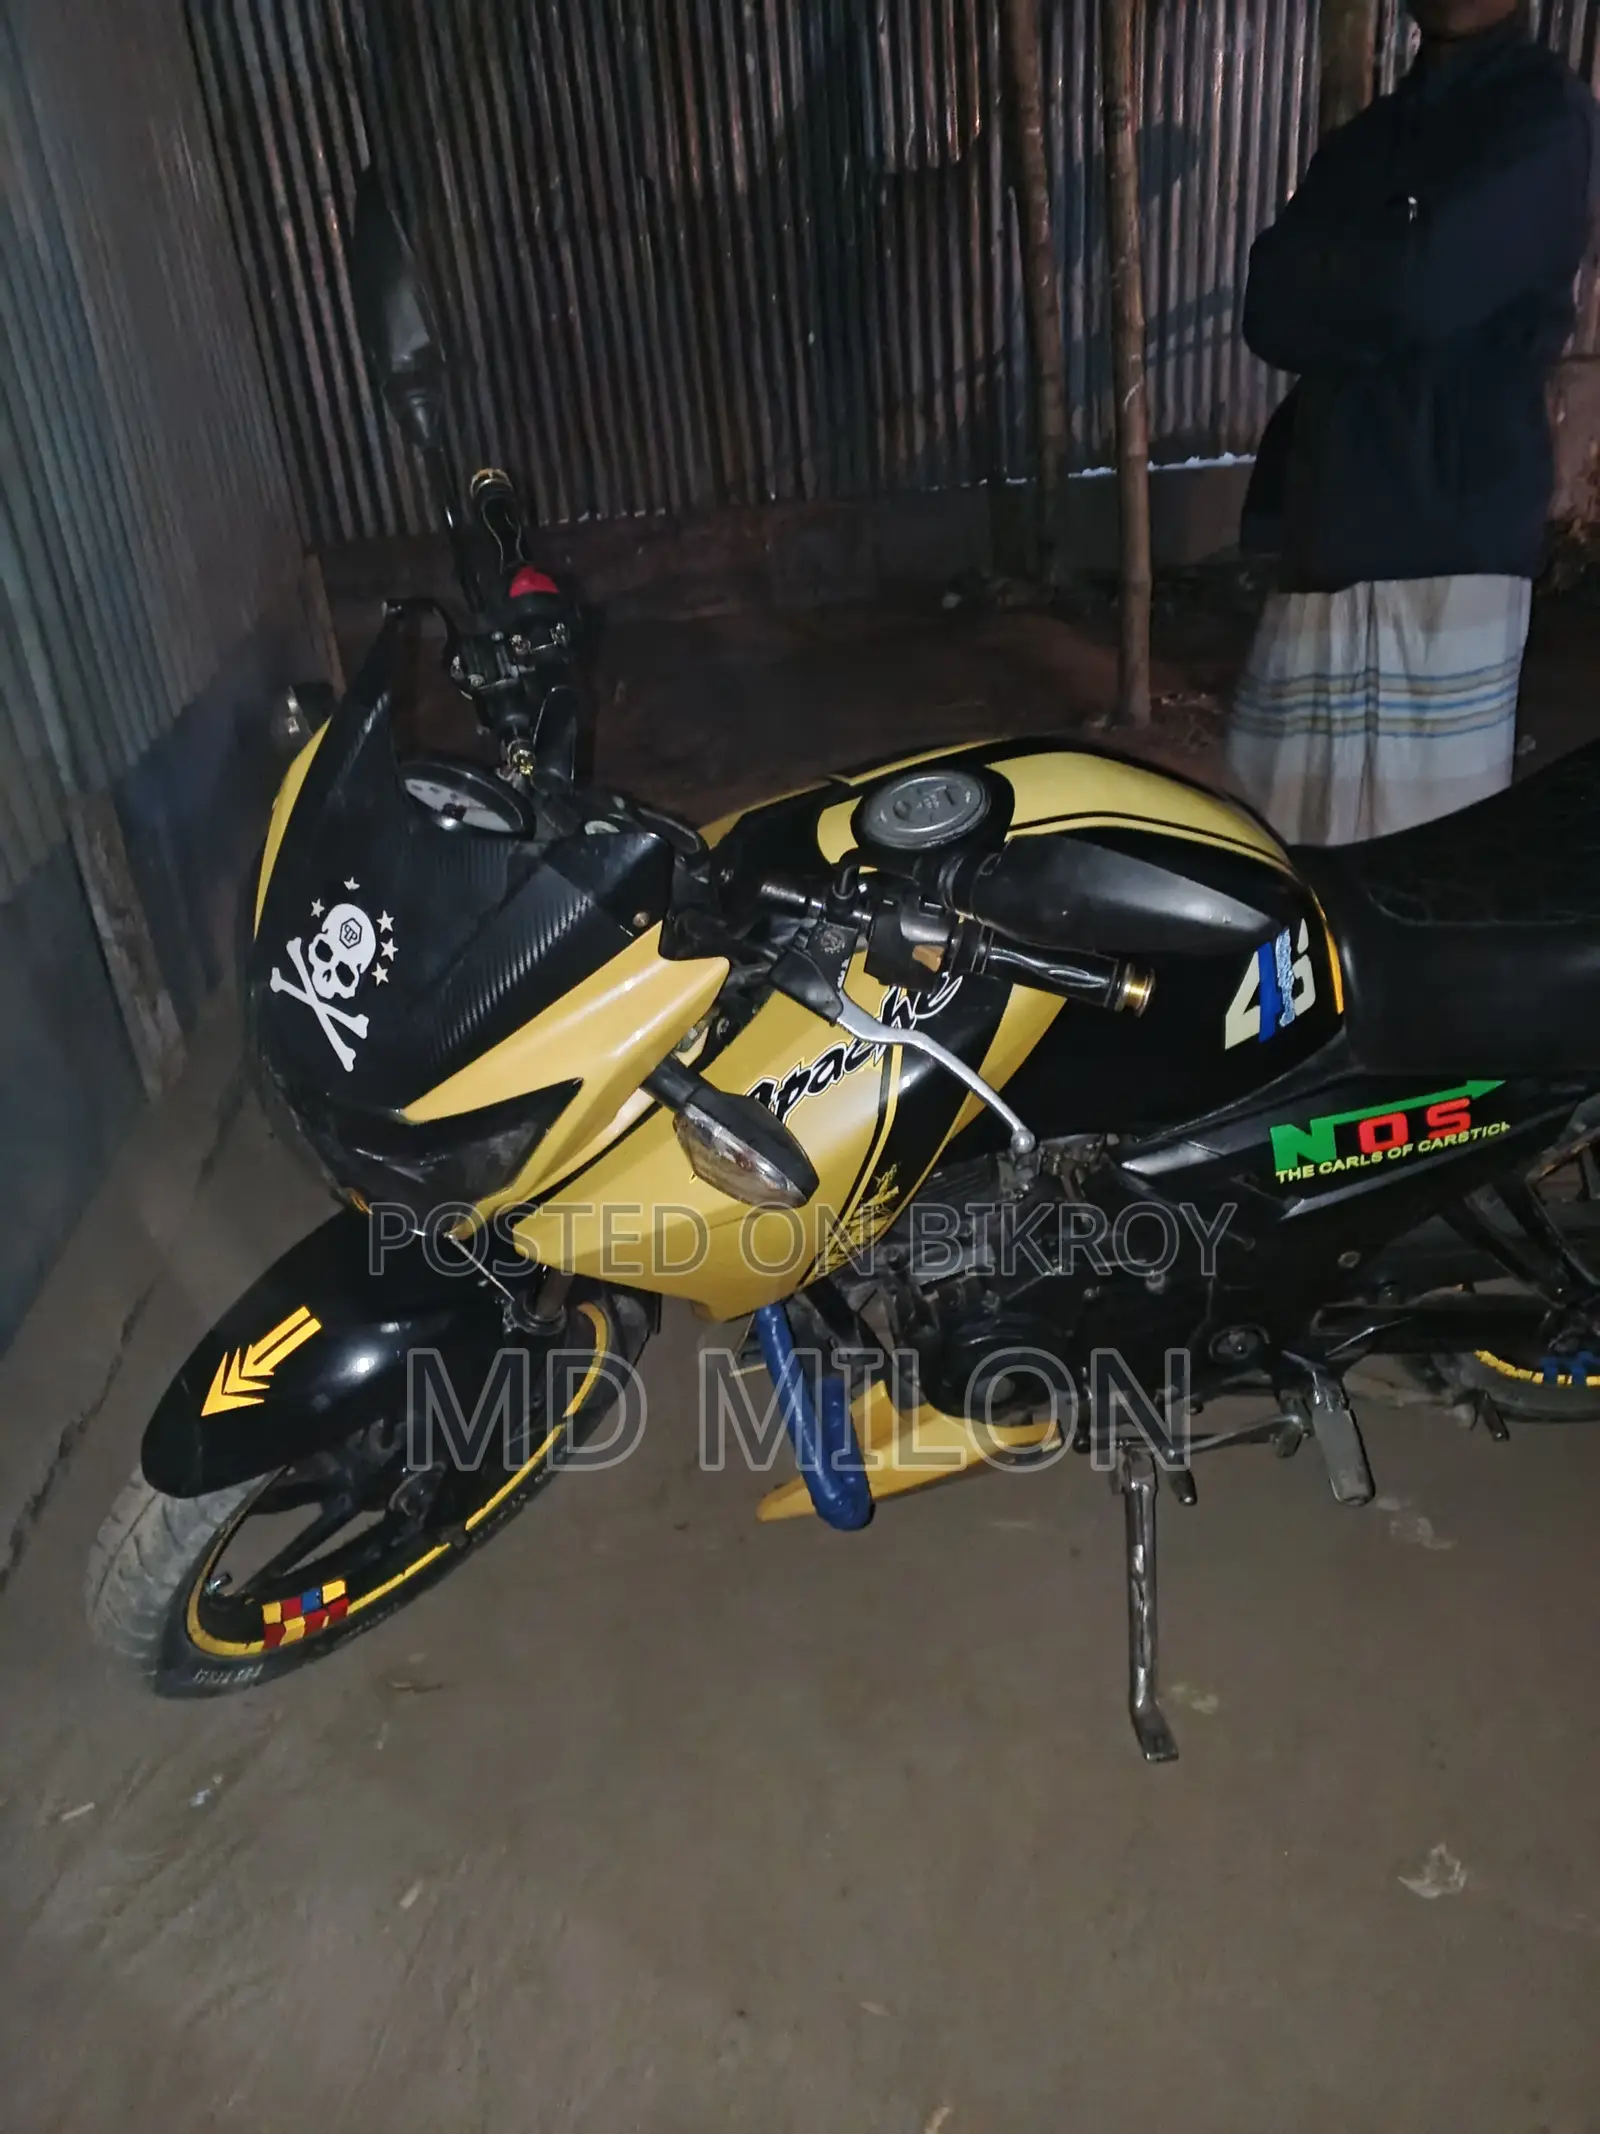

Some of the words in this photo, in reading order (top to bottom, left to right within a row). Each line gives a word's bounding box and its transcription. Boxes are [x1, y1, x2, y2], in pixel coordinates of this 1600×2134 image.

[1270, 1097, 1471, 1171] NOS
[1276, 1164, 1315, 1184] THE
[1387, 1143, 1414, 1160] OF
